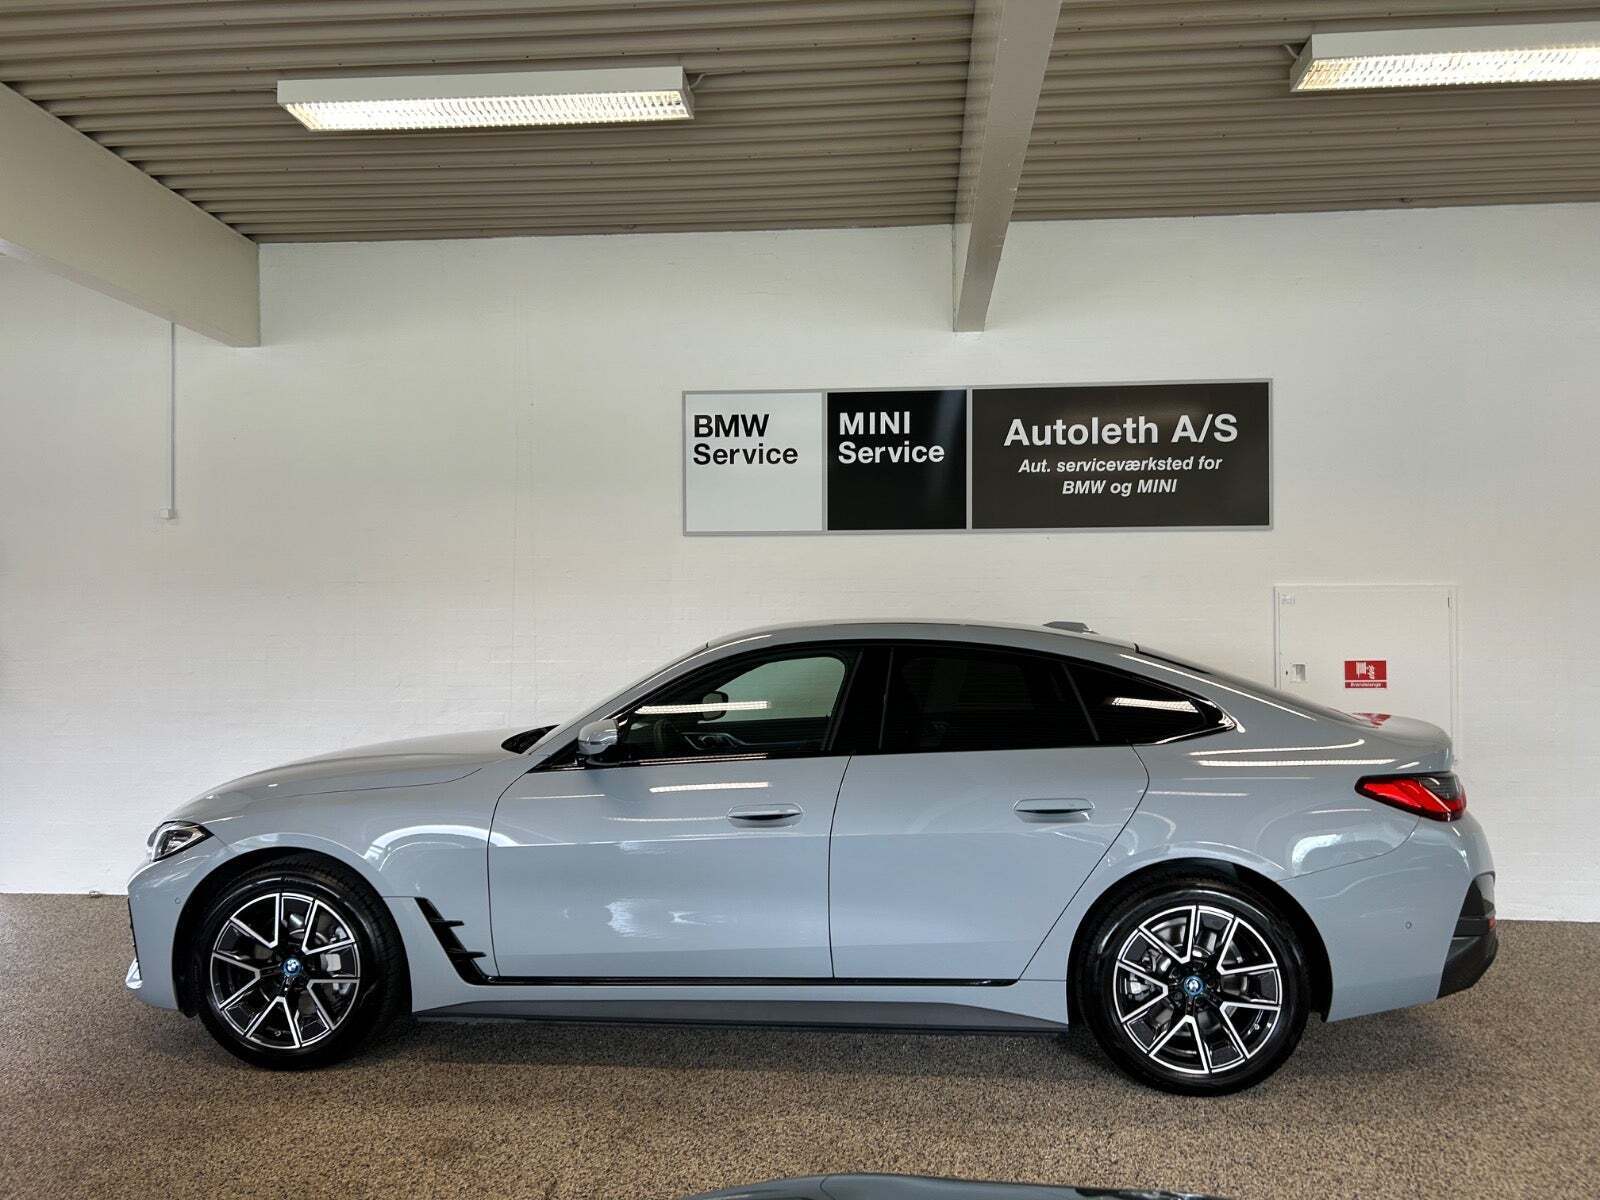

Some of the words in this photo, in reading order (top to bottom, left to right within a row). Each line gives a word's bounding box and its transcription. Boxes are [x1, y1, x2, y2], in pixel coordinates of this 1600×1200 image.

[694, 413, 770, 438] BMW
[839, 411, 910, 435] MINI
[1003, 415, 1159, 447] Autoleth
[1171, 413, 1239, 443] A/S
[692, 442, 799, 466] Service
[838, 440, 945, 464] Service
[1017, 459, 1051, 474] Aut.
[1056, 456, 1194, 473] serviceværksted
[1198, 455, 1224, 470] for
[1062, 479, 1106, 495] BMW
[1110, 482, 1133, 498] og
[1137, 478, 1179, 494] MINI
